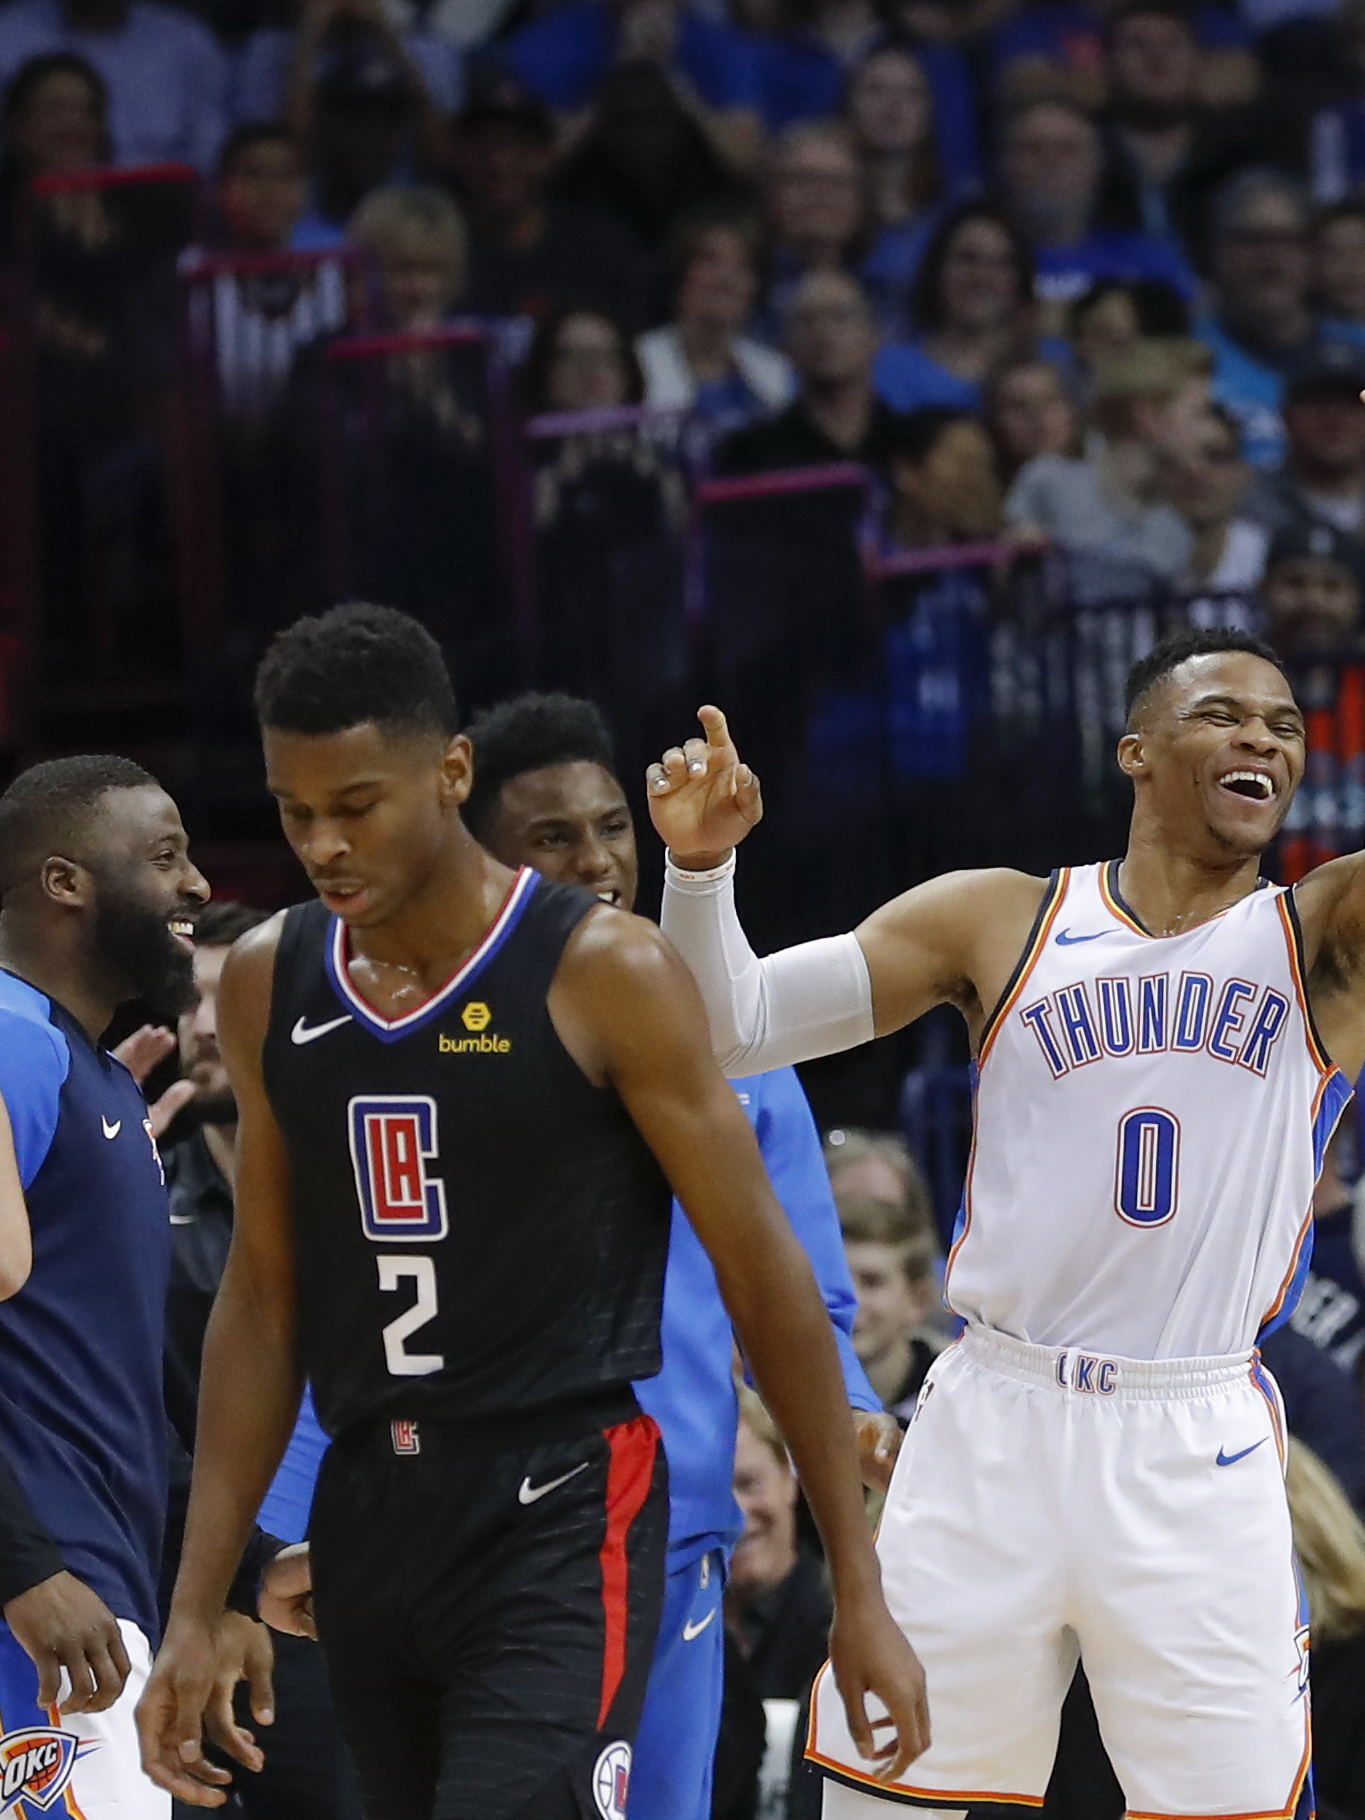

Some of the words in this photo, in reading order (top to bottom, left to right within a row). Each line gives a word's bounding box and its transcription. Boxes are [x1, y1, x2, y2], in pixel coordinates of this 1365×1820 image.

[439, 1033, 511, 1053] bumble
[1019, 970, 1290, 1081] THUNDER
[1114, 1105, 1181, 1228] 0
[376, 1255, 444, 1376] 2
[3, 1741, 58, 1798] OKC
